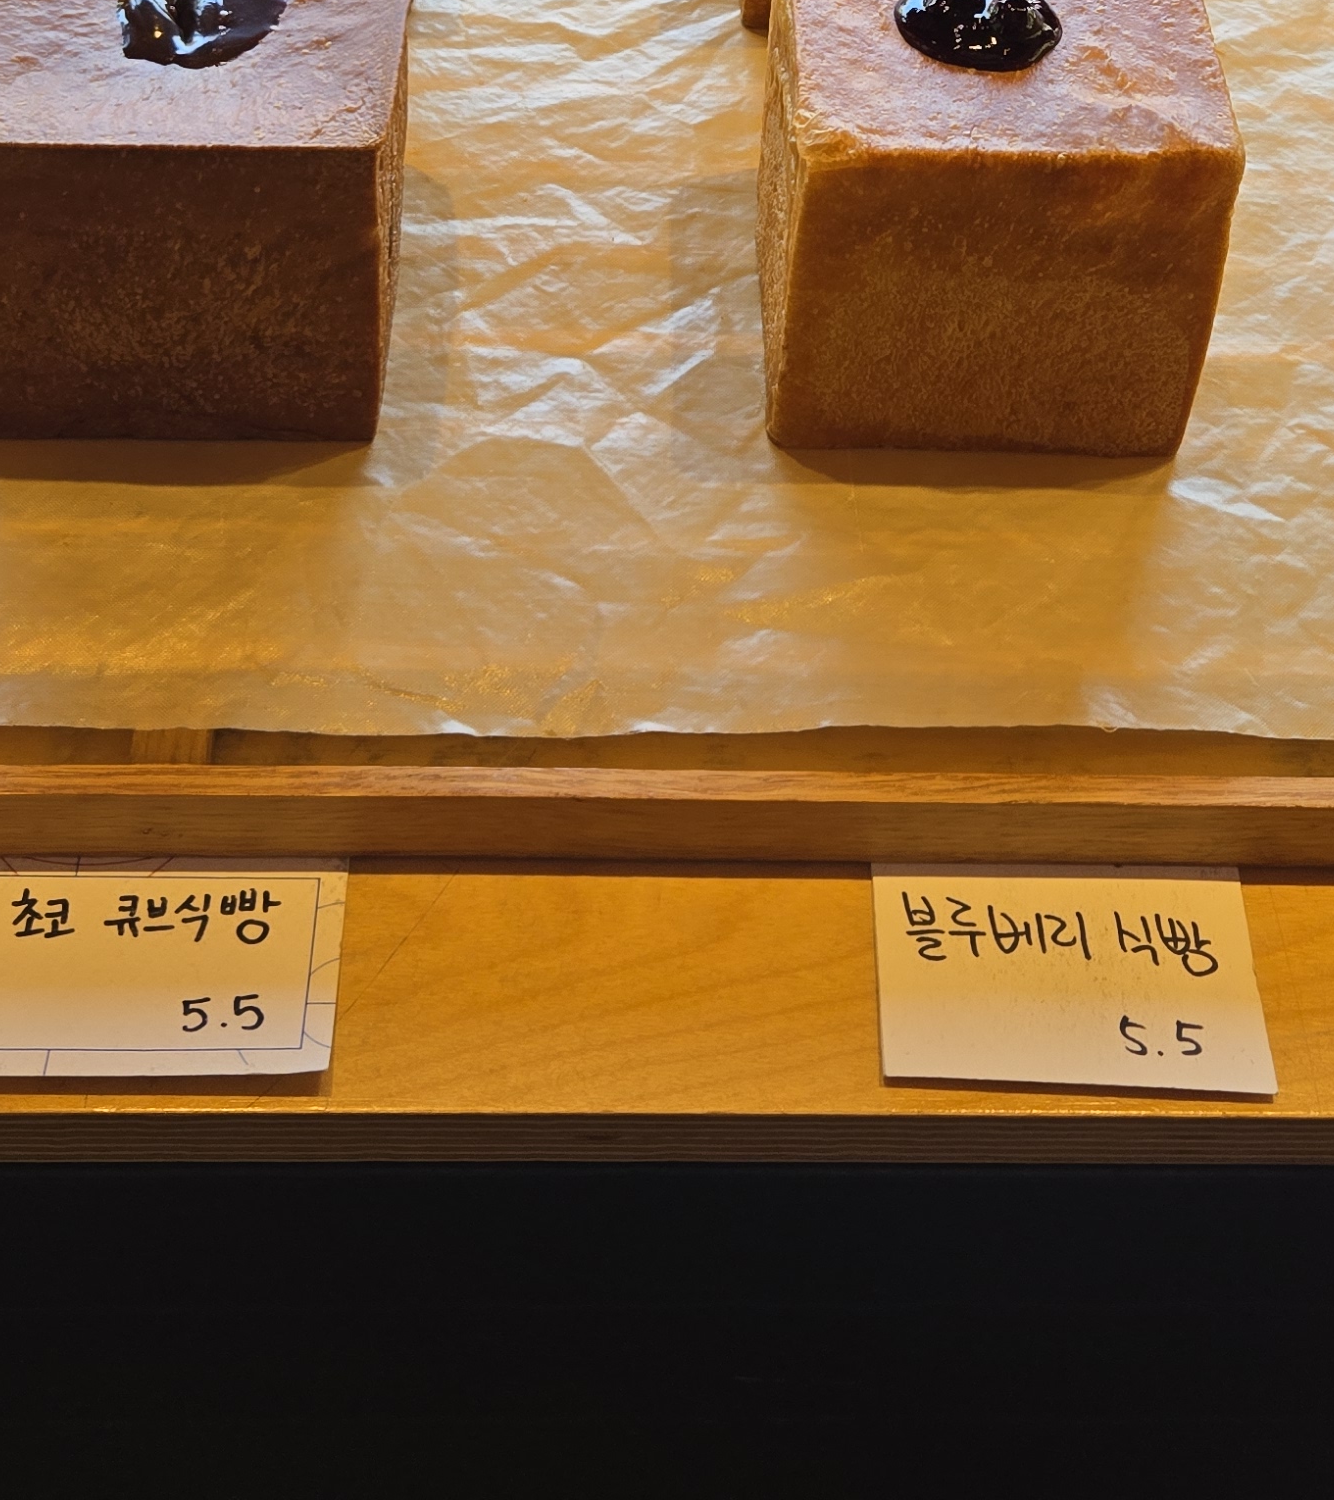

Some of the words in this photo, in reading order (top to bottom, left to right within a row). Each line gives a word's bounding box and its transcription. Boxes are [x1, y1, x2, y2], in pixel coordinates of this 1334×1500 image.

[11, 888, 76, 939] 초코
[103, 888, 282, 945] 큐브식빵
[901, 891, 1092, 961] 블루베리
[1114, 911, 1219, 977] 식빵
[181, 993, 266, 1032] 5.5
[1119, 1014, 1204, 1057] 5.5
